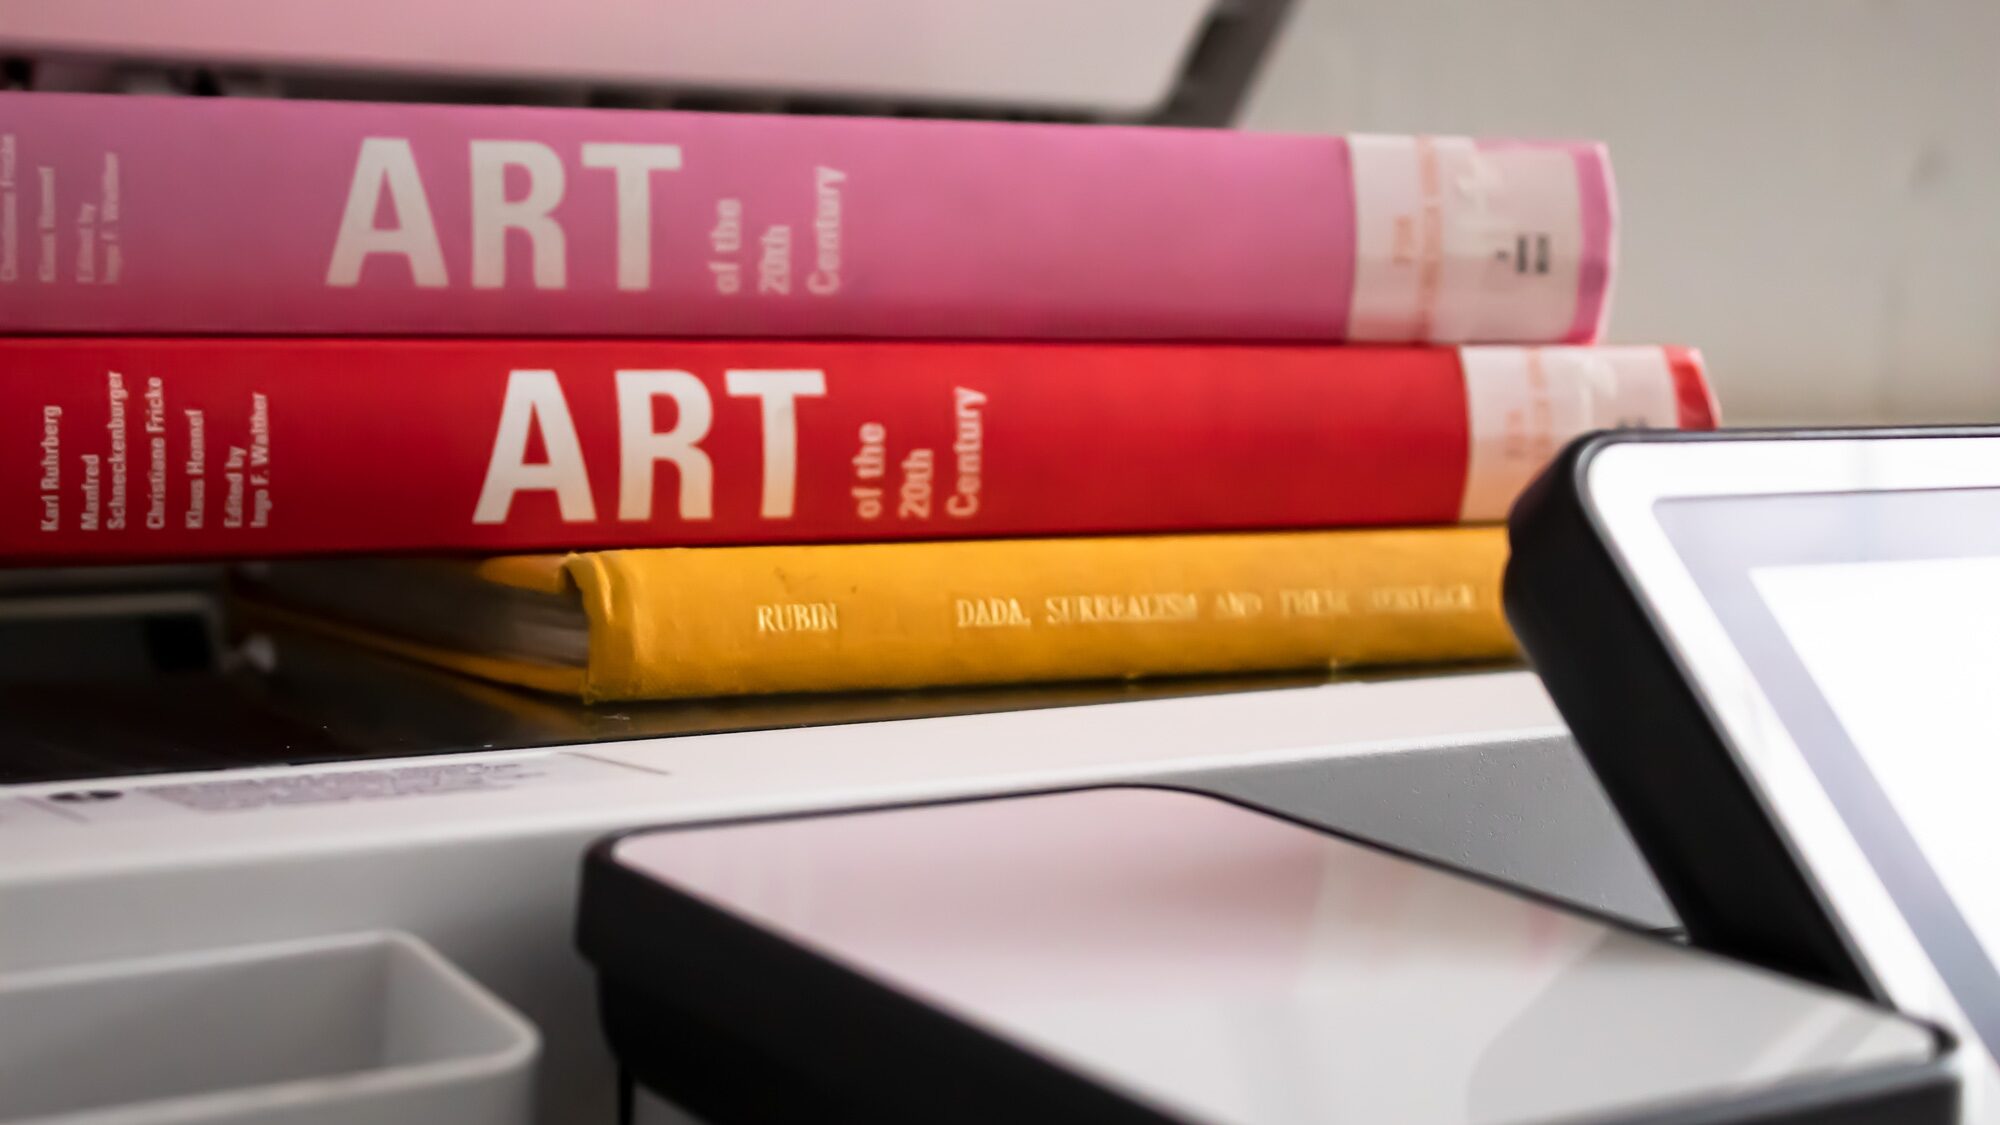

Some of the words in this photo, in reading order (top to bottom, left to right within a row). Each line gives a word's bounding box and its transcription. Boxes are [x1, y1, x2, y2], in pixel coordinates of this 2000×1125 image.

[325, 137, 682, 291] ART
[709, 198, 742, 253] the
[807, 166, 847, 296] Century
[708, 260, 741, 294] of
[758, 225, 791, 295] 20th
[145, 376, 165, 432] Fricke
[250, 392, 269, 465] Walther
[41, 405, 62, 490] Ruhrberg
[107, 371, 128, 529] Schneckenburger
[184, 409, 204, 474] Honnef
[225, 446, 247, 468] by
[472, 369, 827, 525] ART
[852, 422, 885, 479] the
[946, 386, 987, 518] Century
[80, 454, 99, 530] Manfred
[146, 436, 165, 528] Christiane
[185, 478, 205, 528] Klaus
[224, 473, 243, 528] Edited
[250, 468, 268, 485] F.
[851, 487, 883, 519] of
[899, 448, 933, 519] 20th
[41, 494, 59, 531] Karl
[757, 602, 838, 632] RUBIN
[1045, 594, 1198, 624] SURREALISM
